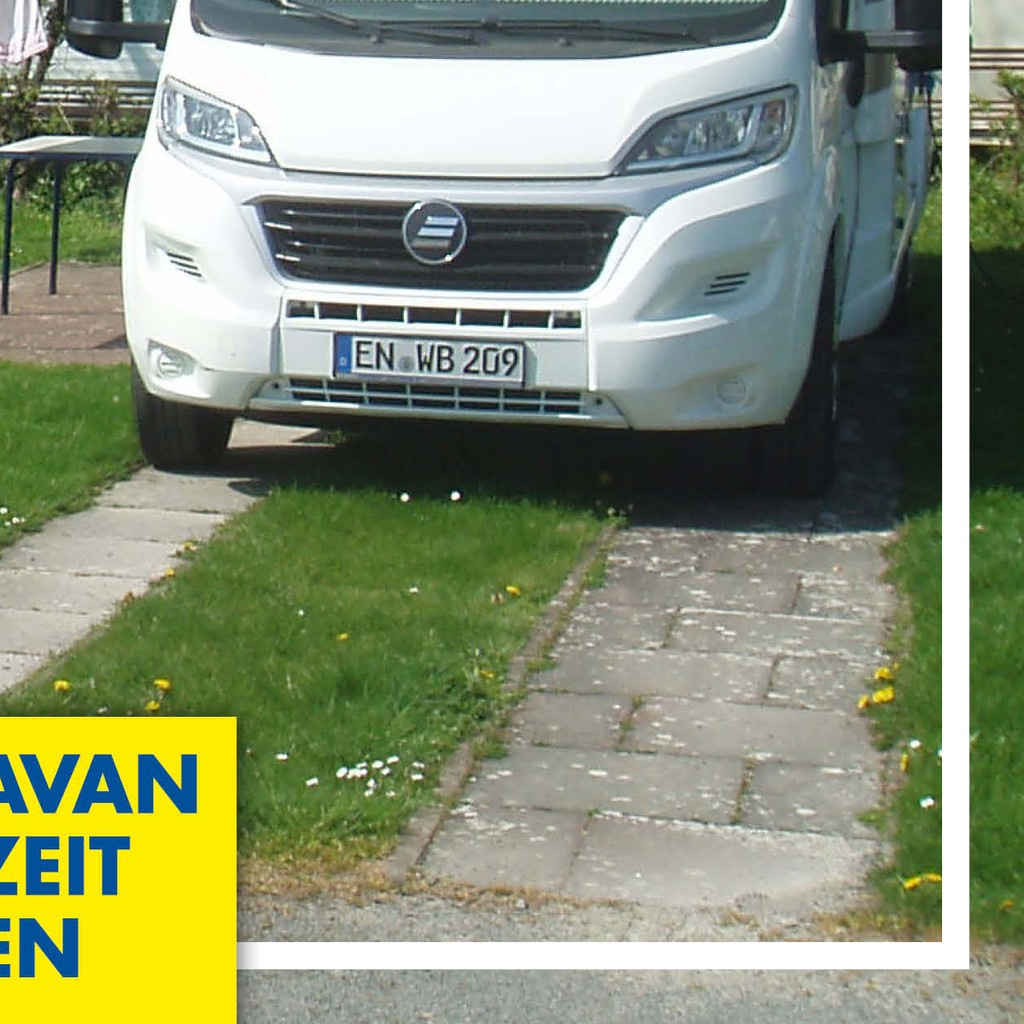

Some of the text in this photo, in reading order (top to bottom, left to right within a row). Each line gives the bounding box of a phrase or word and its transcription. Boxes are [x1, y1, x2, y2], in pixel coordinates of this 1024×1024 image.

[355, 340, 519, 376] EN WB 209
